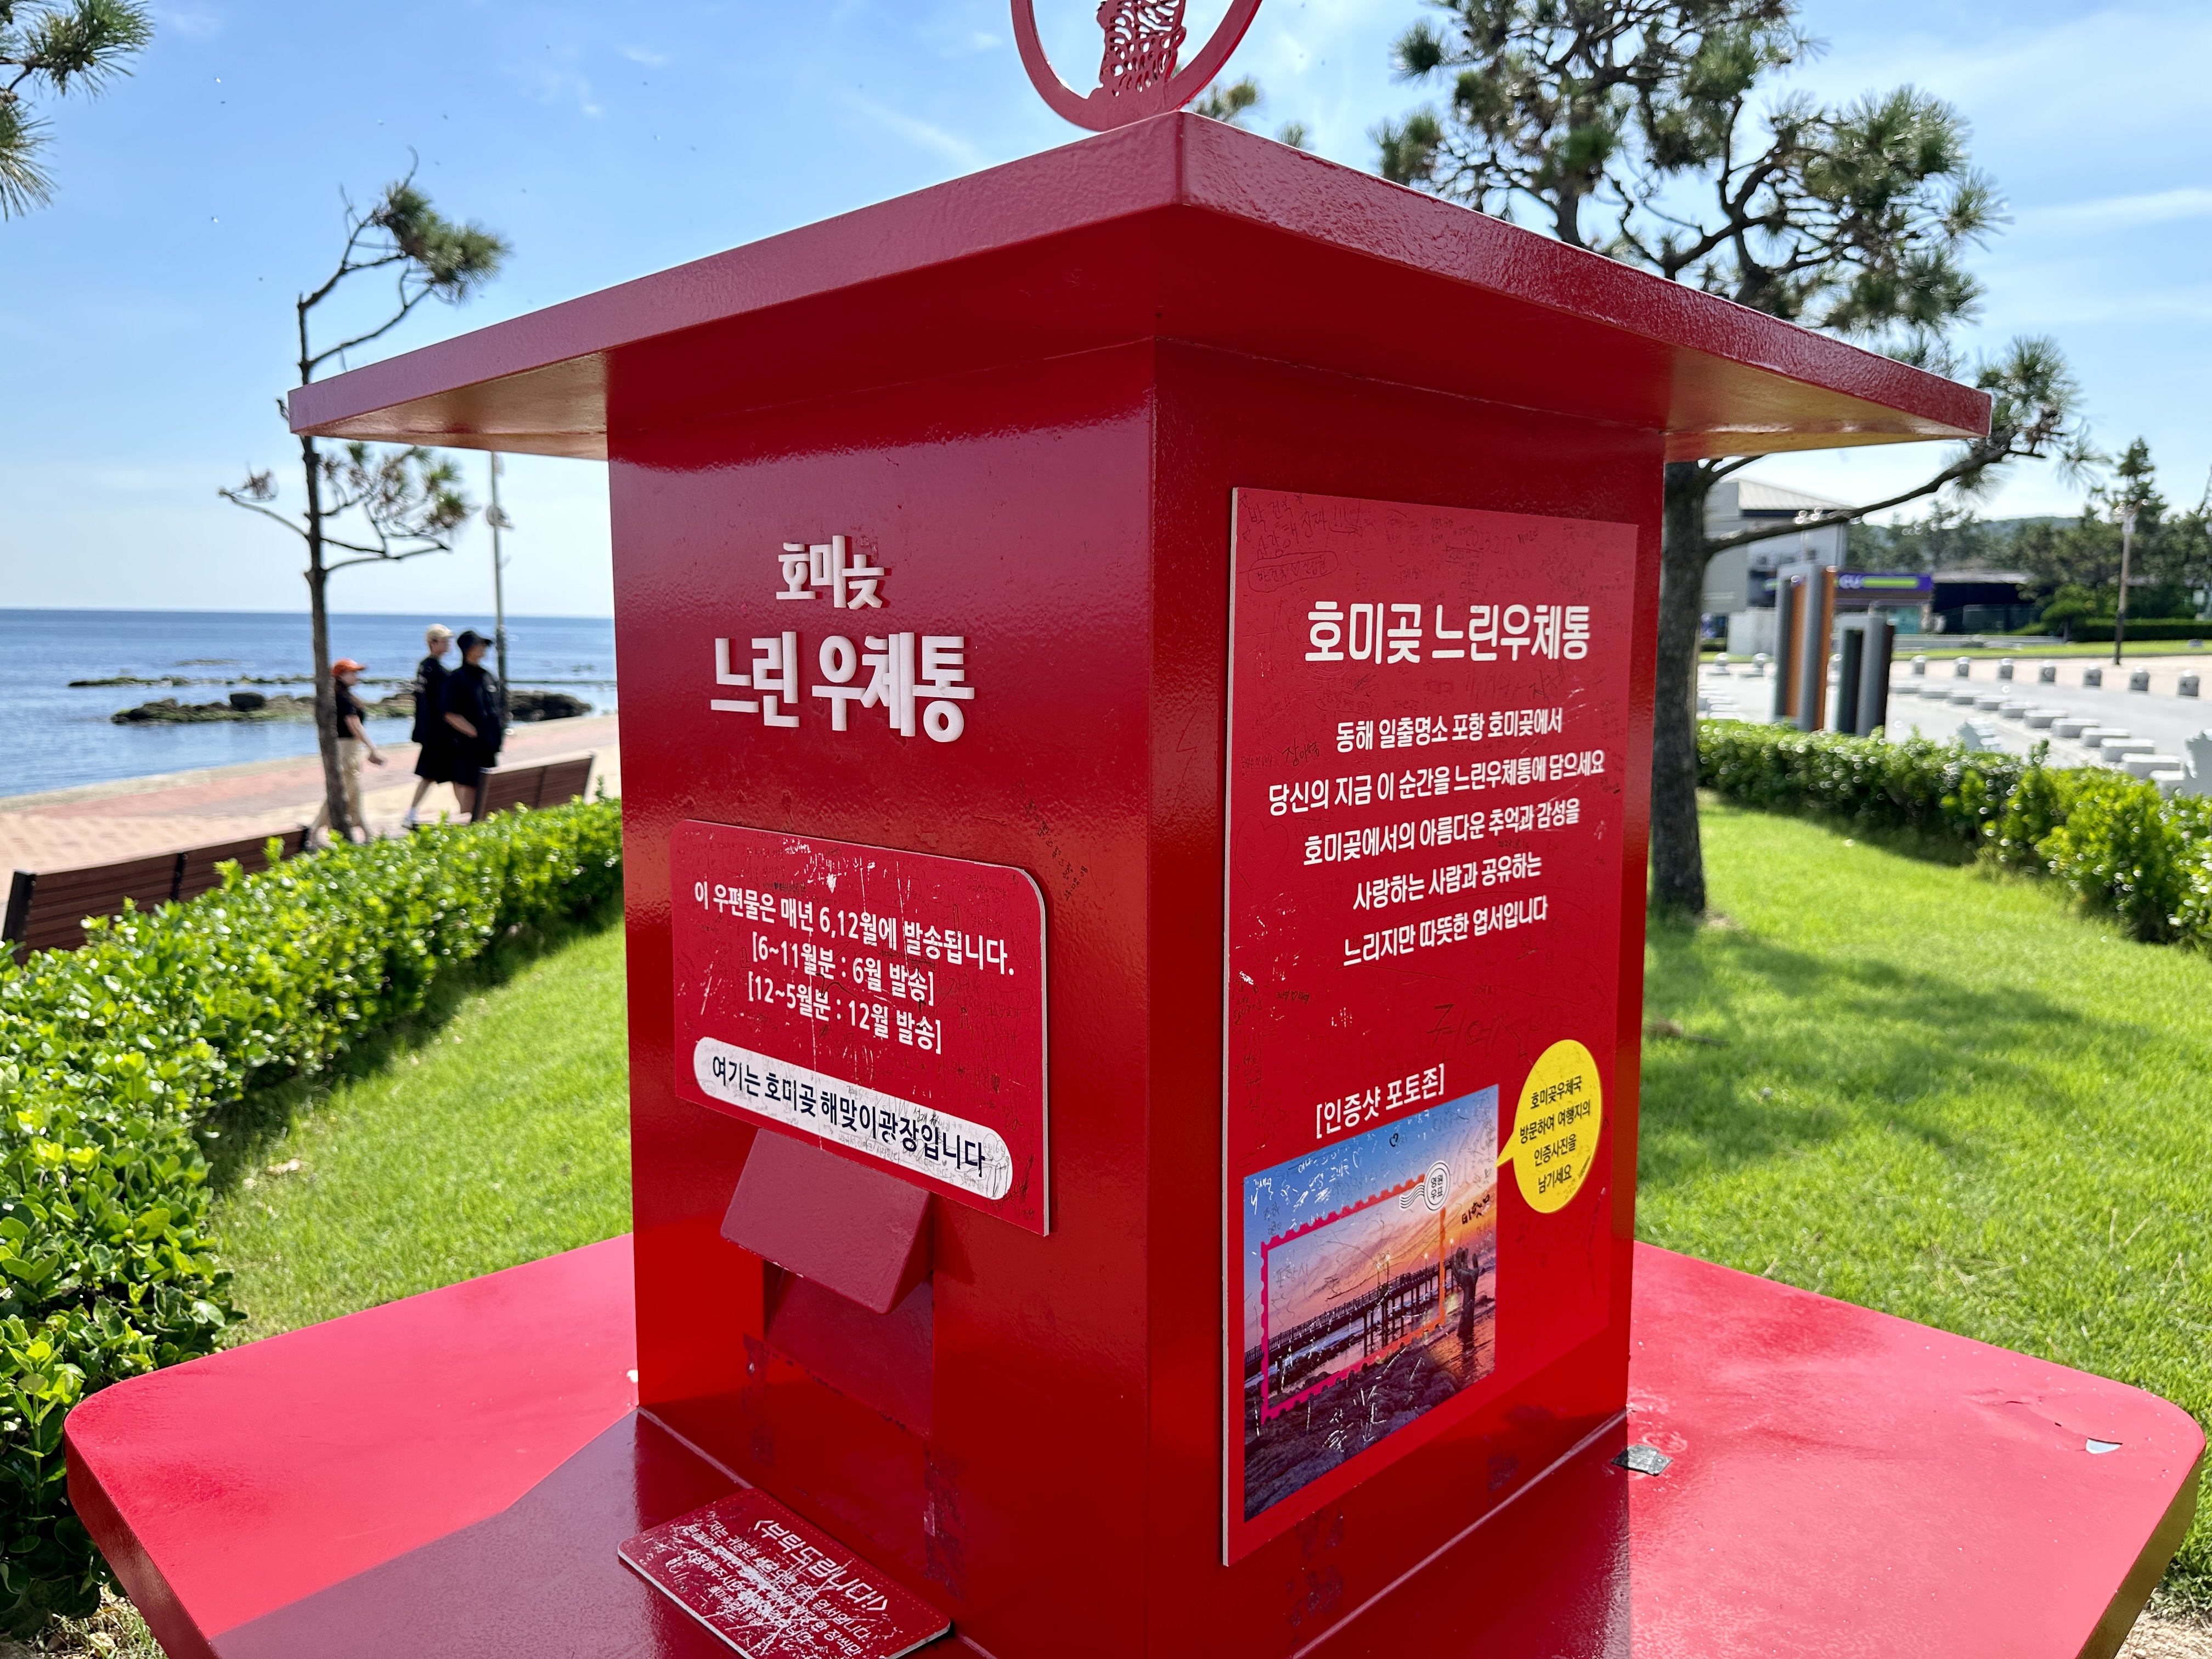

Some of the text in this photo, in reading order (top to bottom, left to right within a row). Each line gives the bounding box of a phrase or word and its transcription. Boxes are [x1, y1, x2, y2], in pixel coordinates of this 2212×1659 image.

[1305, 601, 1590, 664] 호미곶 느린우체통
[711, 631, 974, 743] 느린 우체통
[1335, 708, 1563, 753] 동해 일출명소 포항 호미곶에서
[1268, 749, 1605, 816] 당신의 지금 이 순간을 느린우체통에 담으세요
[1303, 798, 1580, 866] 호미곶에서의 아름다운 추억과 감성을
[1352, 851, 1542, 911] 사랑하는 사람과 공유하는
[695, 881, 1015, 975] 이 우편물은 매년 6,12월에 발송됩니다.
[1344, 895, 1549, 967] 느리지만 따뜻한 엽서입니다
[752, 932, 836, 980] [6~11월분
[853, 958, 882, 992] 6월
[889, 962, 934, 1007] 발송]
[748, 970, 831, 1022] [12~5월분
[849, 1000, 889, 1039] 12월
[896, 1009, 941, 1054] 발송]
[713, 1056, 761, 1097] 여기는
[765, 1072, 817, 1117] 호미곶
[820, 1091, 985, 1178] 해맞이광장입니다
[1316, 1063, 1444, 1139] [인증샷 포토존]
[1519, 1098, 1591, 1144] 방문하여 여행지의
[1530, 1075, 1582, 1109] 호미곶우체국
[1534, 1133, 1576, 1167] 인증사진을
[1538, 1164, 1572, 1194] 남기세요
[1431, 1186, 1443, 1200] 우표
[682, 1547, 745, 1592] 사용해주시면
[704, 1520, 732, 1538] 저는
[723, 1534, 760, 1559] 귀중한
[810, 1599, 874, 1643] 엽서입니다.
[810, 1620, 830, 1632] 한
[821, 1628, 864, 1657] 장씩만
